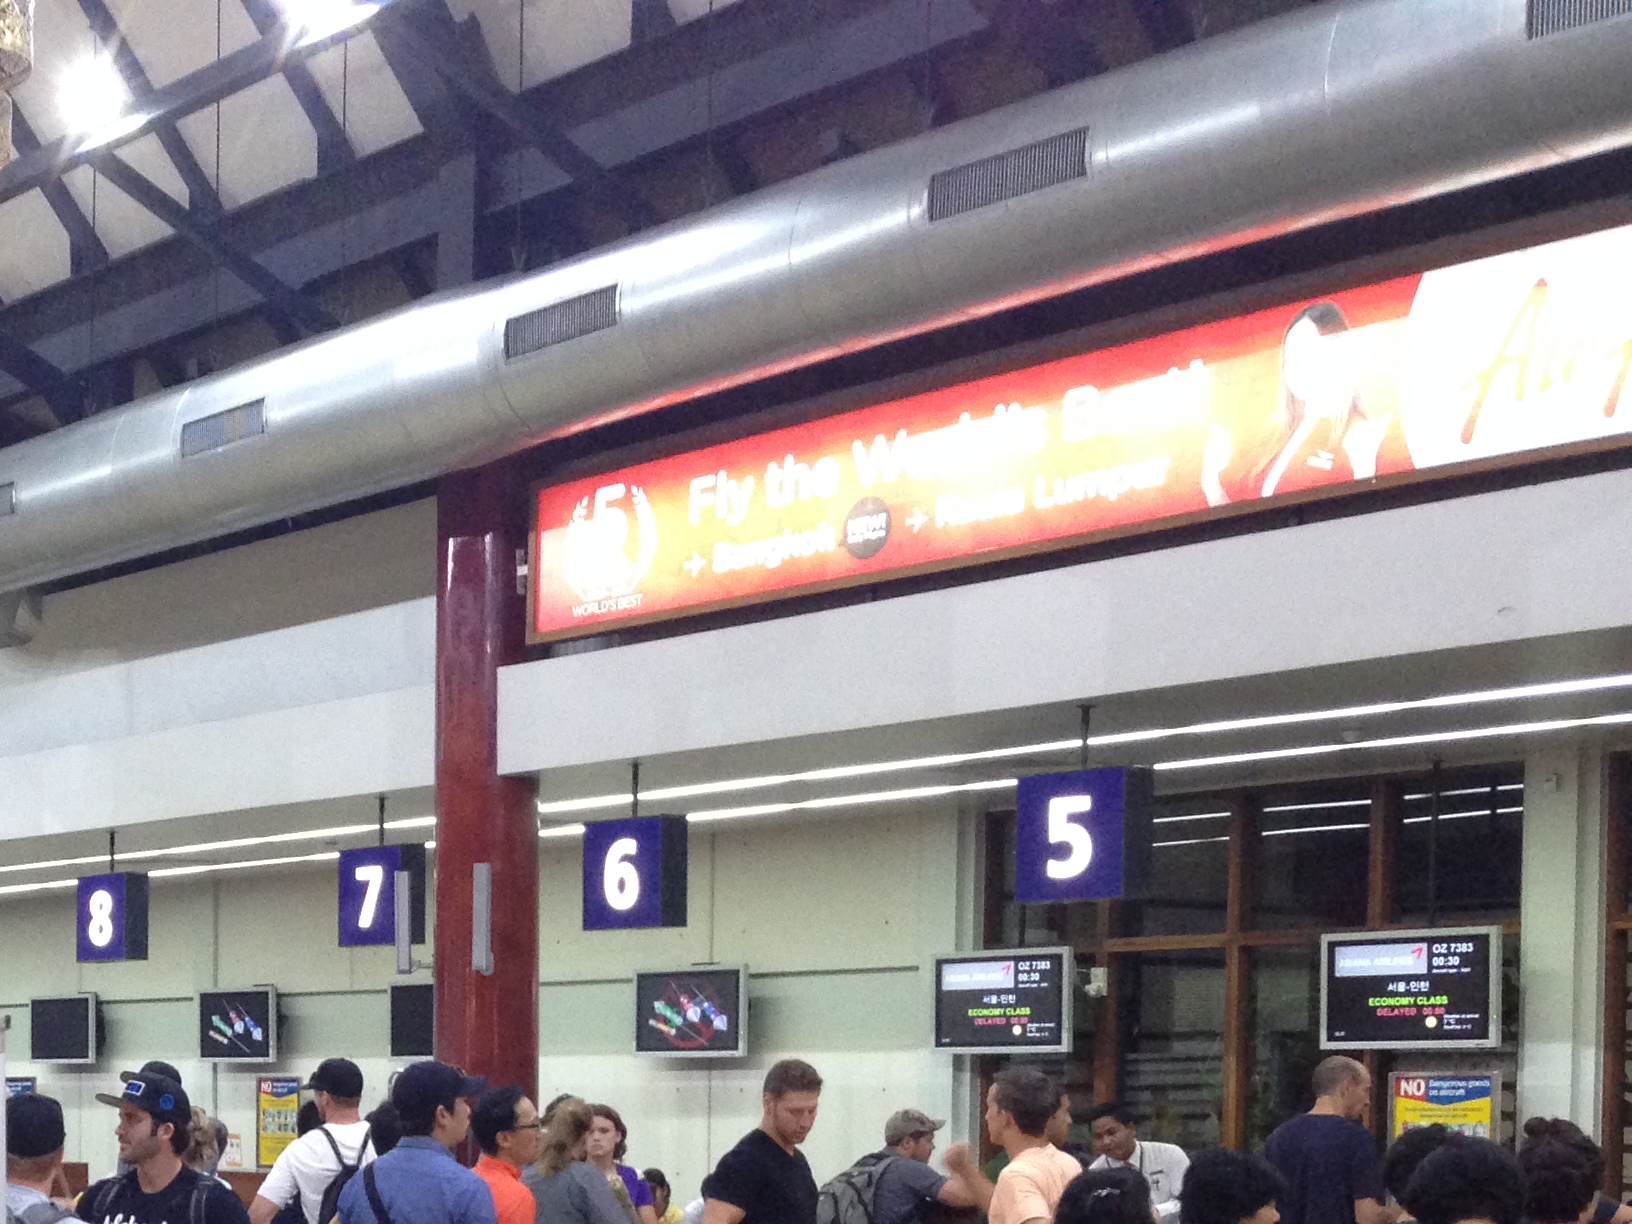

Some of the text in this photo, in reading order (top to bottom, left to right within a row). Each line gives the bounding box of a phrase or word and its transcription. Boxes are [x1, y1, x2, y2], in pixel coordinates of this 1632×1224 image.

[688, 470, 754, 526] Fly
[764, 454, 840, 508] the
[572, 599, 616, 618] WORLD'S
[617, 593, 643, 608] BEST
[1047, 795, 1093, 879] 5
[603, 838, 640, 910] 6
[355, 865, 382, 928] 7
[88, 890, 113, 947] 8
[1432, 942, 1474, 954] OZ 7383
[1018, 962, 1030, 971] OZ
[1432, 956, 1460, 967] 00:30
[1368, 995, 1448, 1007] ECONOMY CLASS
[968, 1007, 1031, 1017] ECONOMY CLASS
[1376, 1008, 1417, 1016] DELAYED
[260, 1081, 272, 1092] NO
[1399, 1079, 1426, 1096] NO
